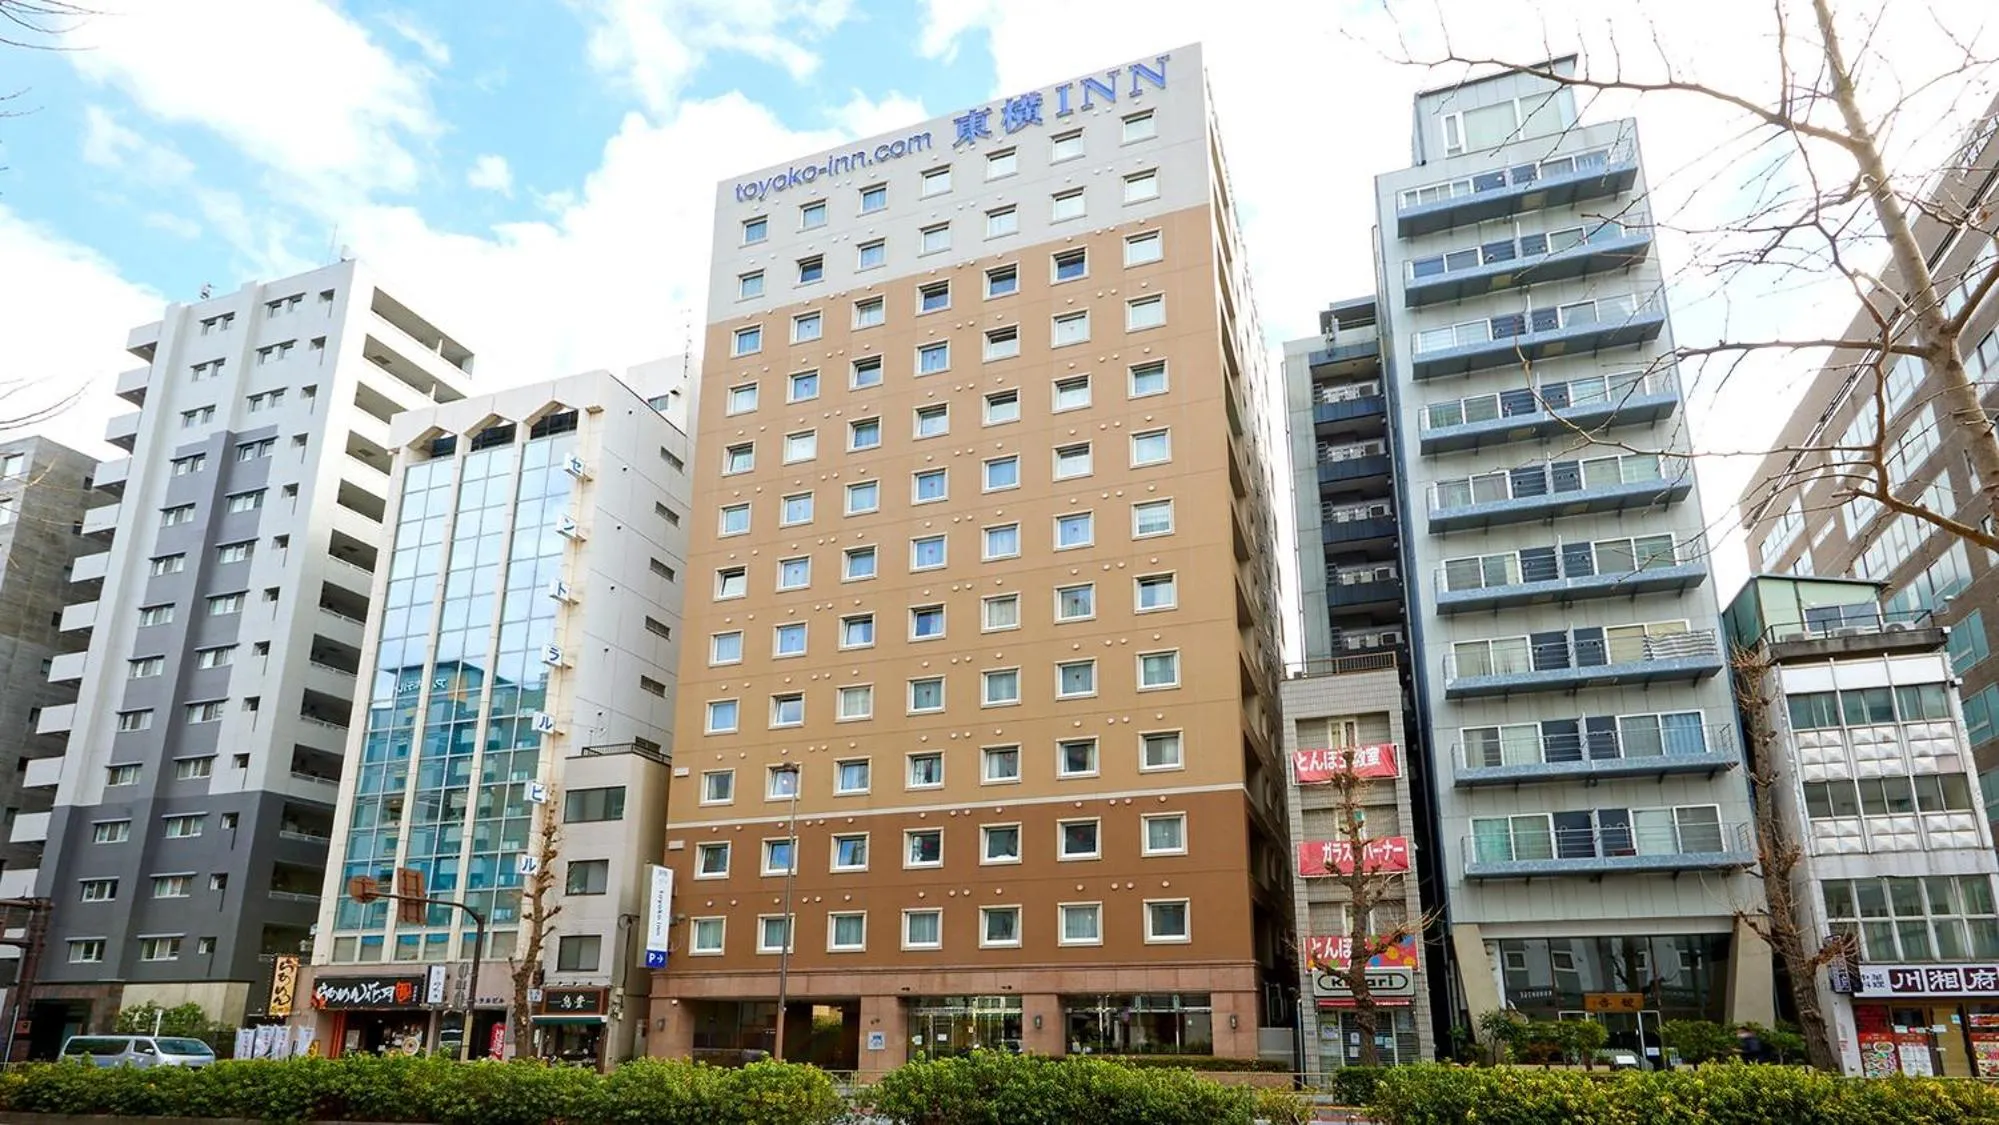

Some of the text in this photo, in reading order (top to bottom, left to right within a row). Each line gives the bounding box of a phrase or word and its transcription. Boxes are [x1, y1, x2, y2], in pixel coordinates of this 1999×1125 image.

[735, 132, 932, 202] toyoko-inn.com
[648, 952, 656, 963] P
[1892, 969, 1996, 991] 川湘府
